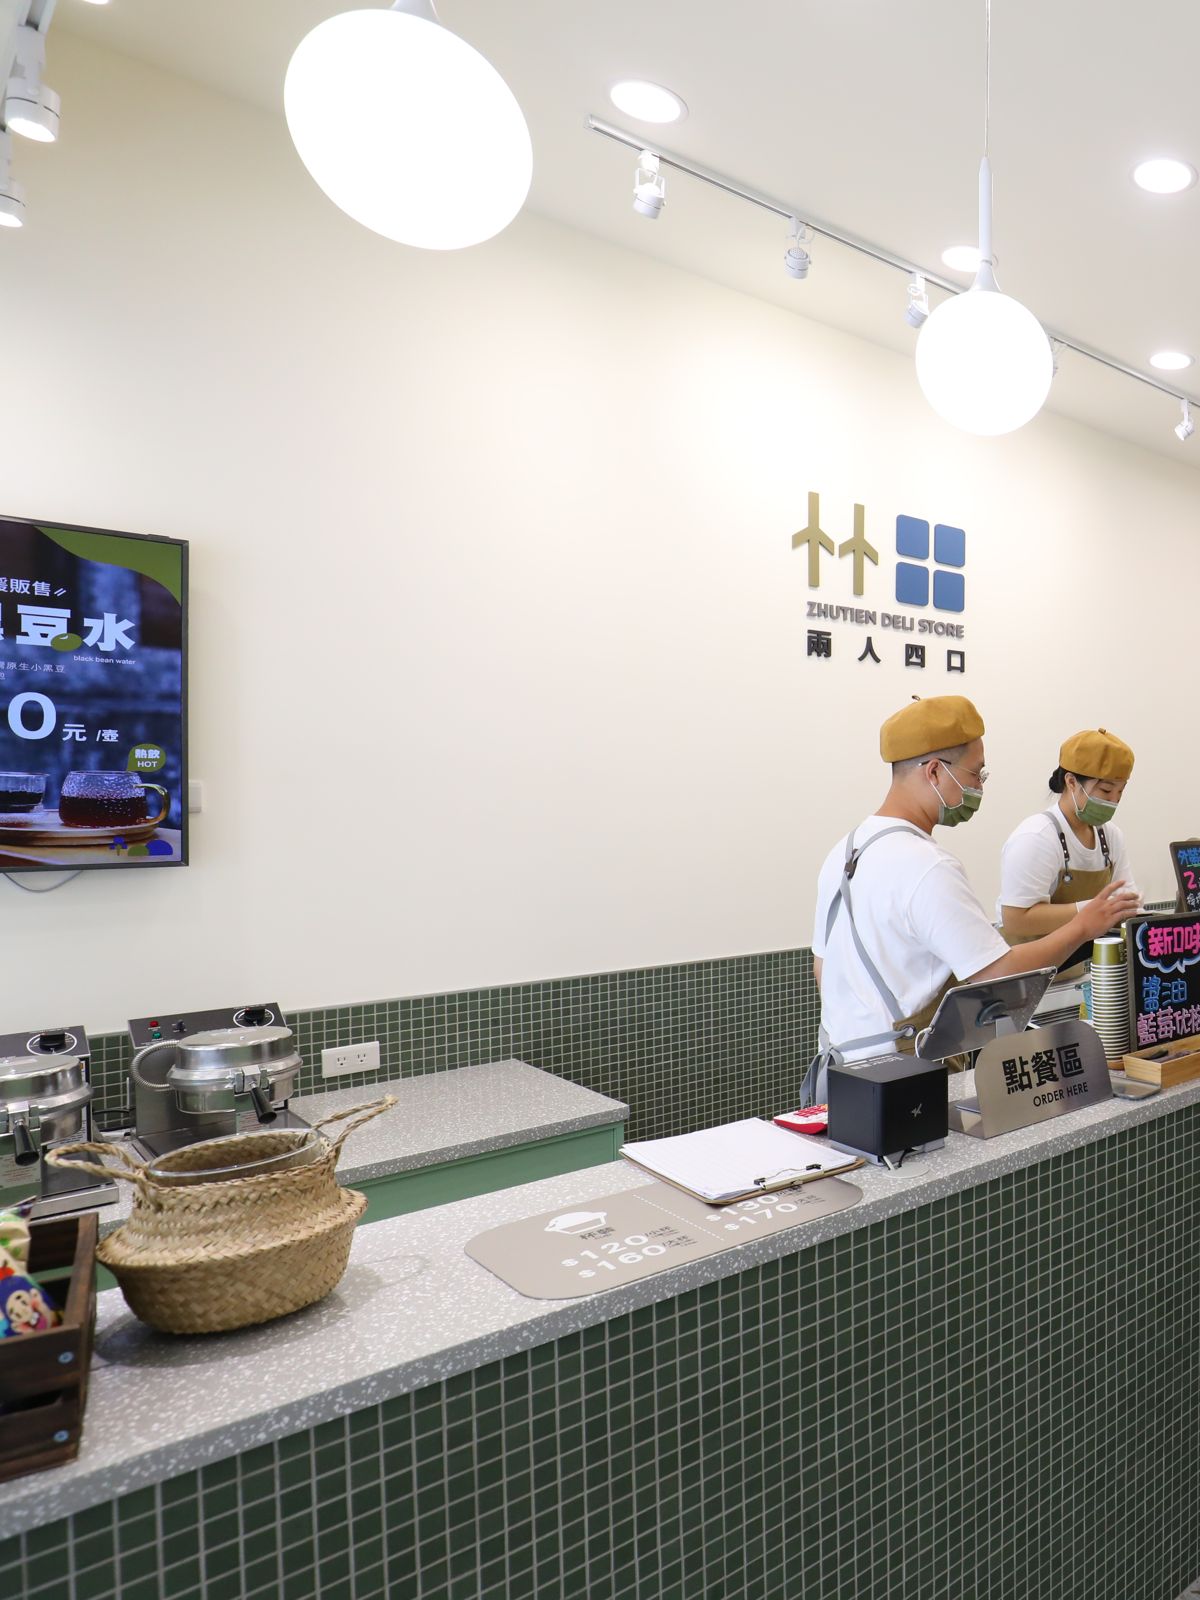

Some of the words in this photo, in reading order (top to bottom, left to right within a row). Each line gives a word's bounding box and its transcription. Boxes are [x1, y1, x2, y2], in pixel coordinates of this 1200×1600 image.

[0, 602, 136, 652] 豆水
[806, 600, 877, 626] ZHUTIEN
[880, 612, 915, 631] DELI
[918, 618, 965, 639] STORE
[95, 656, 114, 664] bean
[1002, 1042, 1085, 1095] 點餐區
[1033, 1089, 1065, 1107] ORDER
[1066, 1081, 1089, 1097] HERE
[705, 1194, 779, 1222] $130
[724, 1203, 798, 1231] $170
[561, 1235, 649, 1267] $120
[578, 1245, 666, 1279] $160
